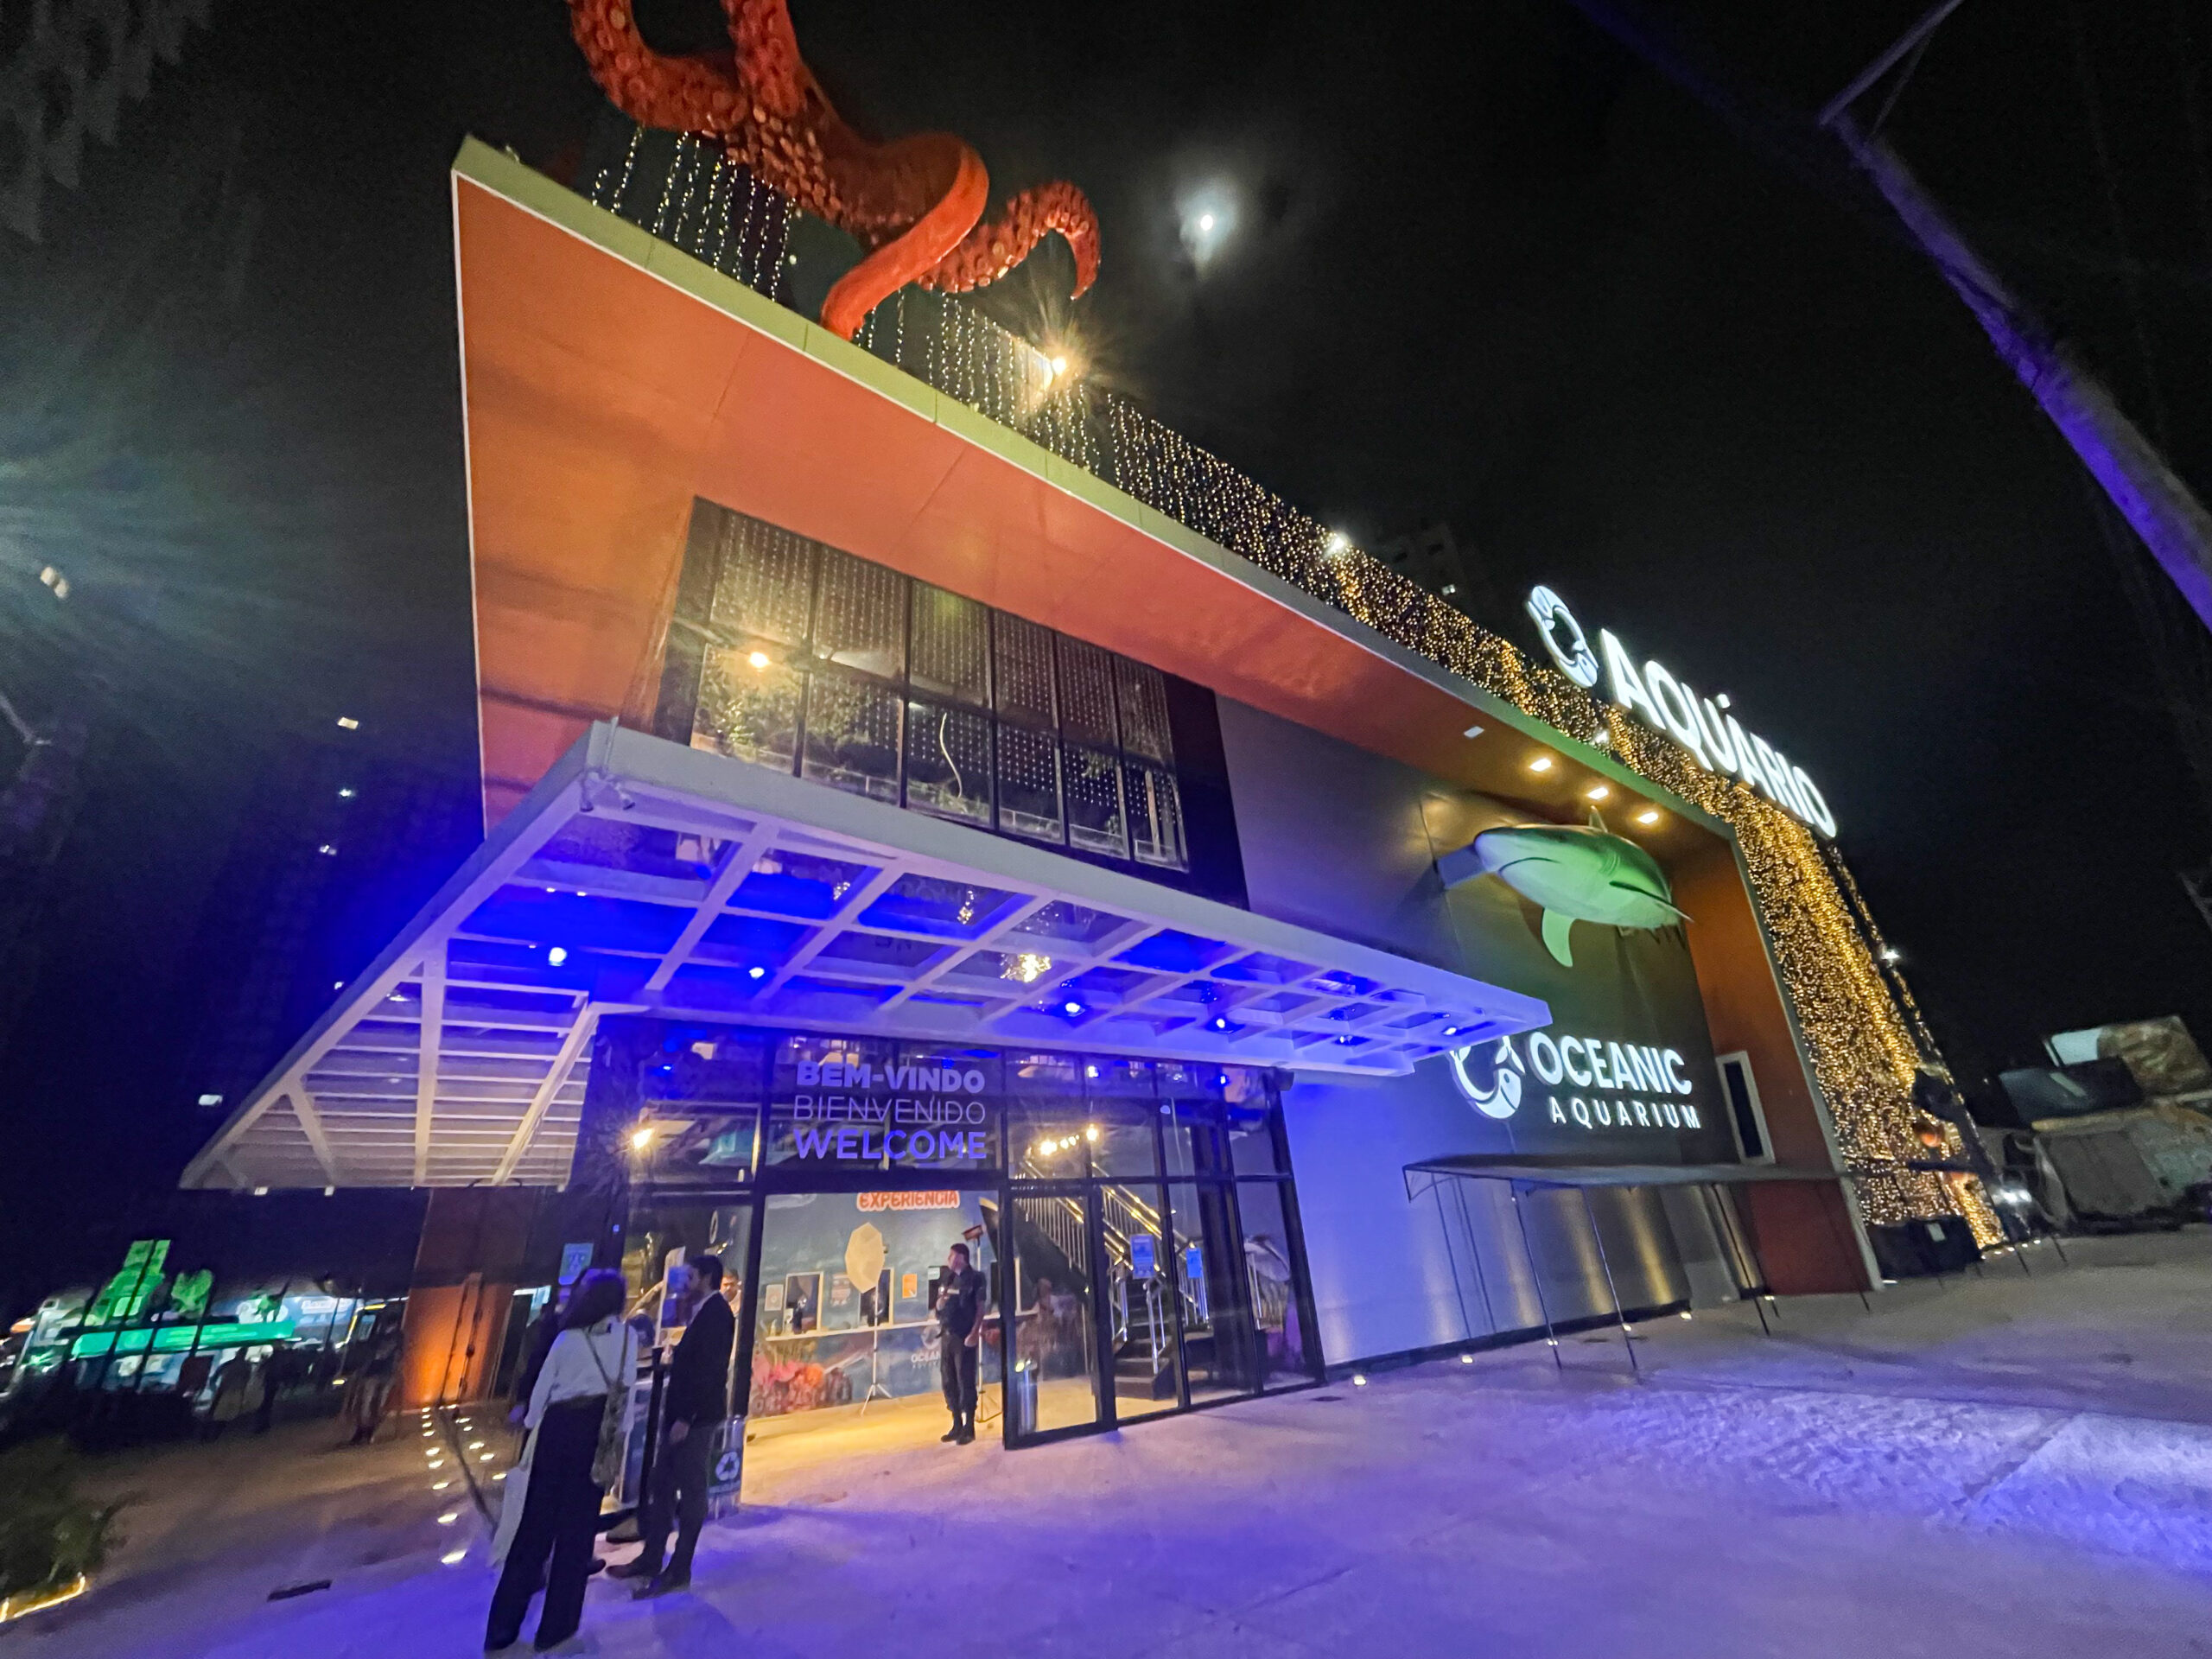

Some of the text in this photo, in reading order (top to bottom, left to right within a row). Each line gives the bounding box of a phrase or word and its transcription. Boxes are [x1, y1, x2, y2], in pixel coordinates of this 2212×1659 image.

[1600, 627, 1837, 838] AQUÁRIO
[796, 1060, 986, 1094] BEM-VINDO
[1527, 1031, 1693, 1095] OCEANIC
[792, 1095, 986, 1124] BIENVENIDO
[1549, 1096, 1701, 1129] AQUARIUM
[792, 1128, 987, 1160] WELCOME
